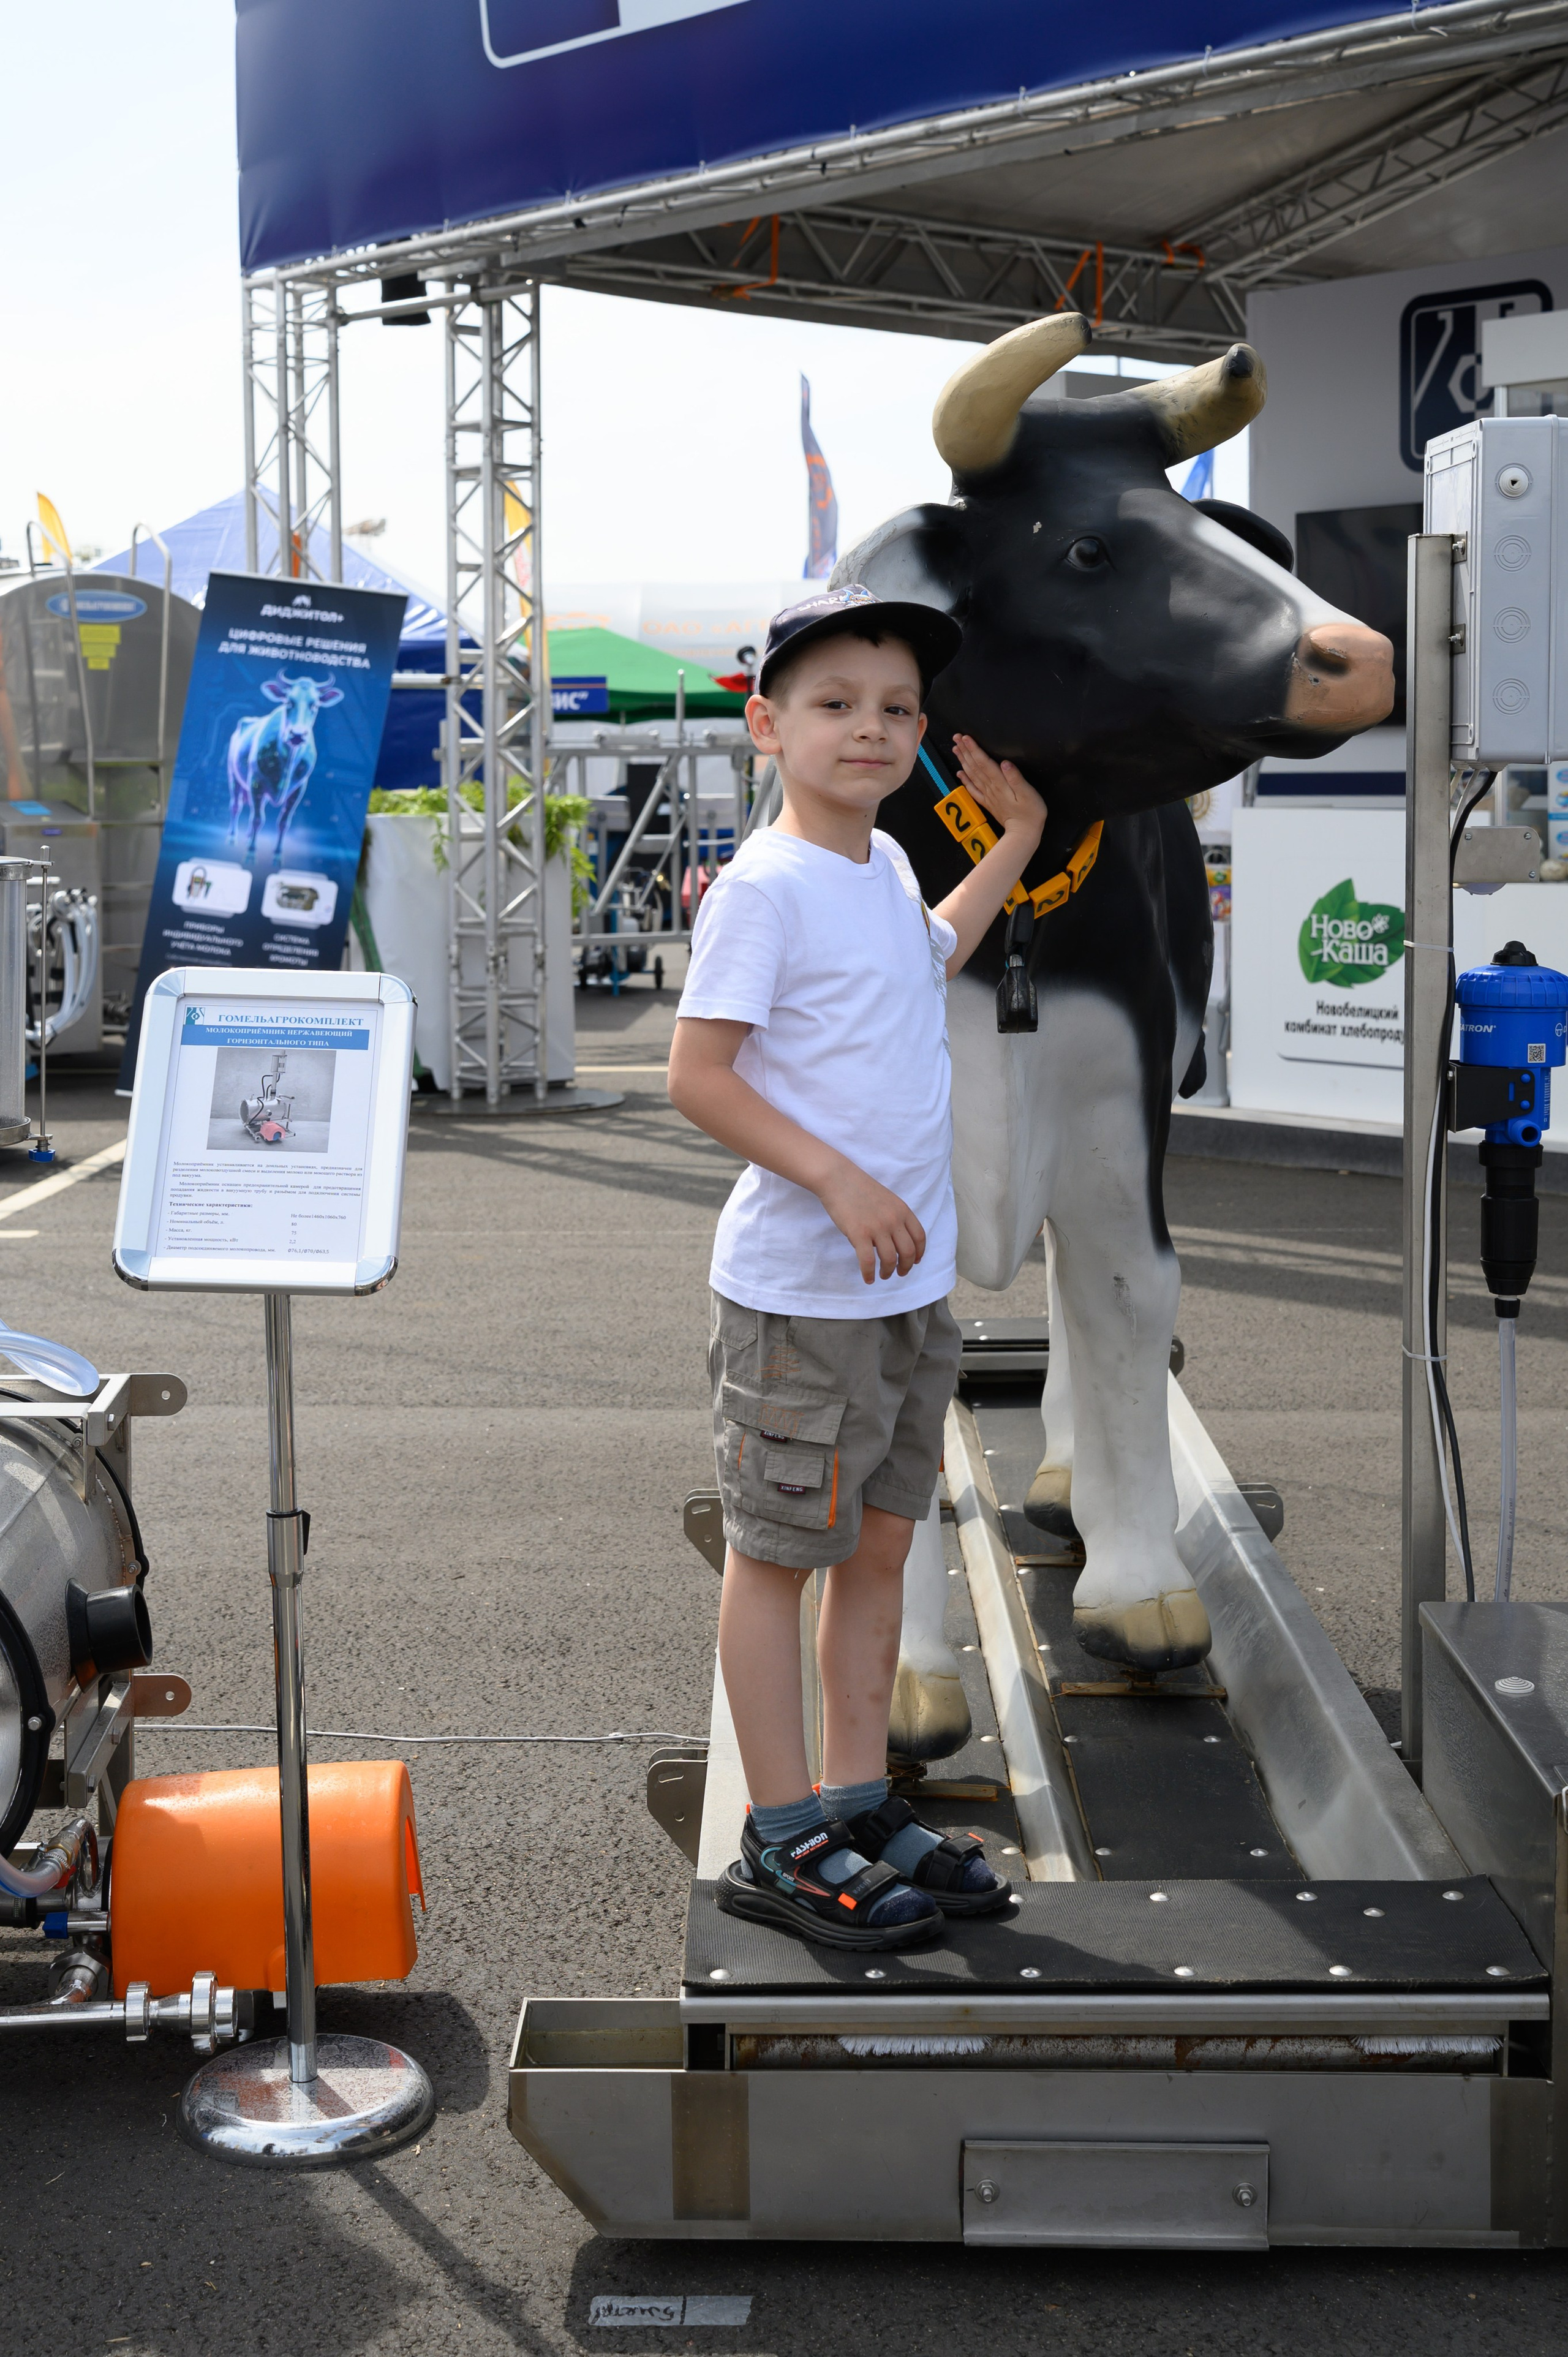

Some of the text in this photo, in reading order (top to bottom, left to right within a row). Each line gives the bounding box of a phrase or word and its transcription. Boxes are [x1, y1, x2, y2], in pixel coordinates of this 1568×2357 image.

[260, 604, 345, 623] ДИДЖИТОЛ+
[643, 620, 701, 635] ОАО
[228, 628, 367, 654] ЦИФРОВЫЕ РЕШЕНИЯ
[218, 641, 371, 669] ДЛЯ ЖИВОТНОВОДСТВА
[946, 802, 971, 832] 2
[971, 838, 986, 860] 2
[184, 921, 225, 934] ПРИБОРЫ
[162, 929, 244, 948] ИНДИВИДУАЛЬНОГО
[273, 933, 310, 946] СИСТЕМА
[195, 943, 232, 956] МОЛОКА
[262, 942, 319, 957] ОПРЕДЕЛЕНИЯ
[1316, 1000, 1399, 1022] Новобелицкий
[218, 1014, 364, 1025] ГОМЕЛЬАГРОКОМПЛЕКТ
[205, 1026, 286, 1035] МОЛОКОПРИЁМНИК
[1285, 1019, 1336, 1036] комбинат
[227, 1038, 306, 1046] ГОРИЗОНТАЛЬНОГО
[782, 1872, 795, 1882] SPORT
